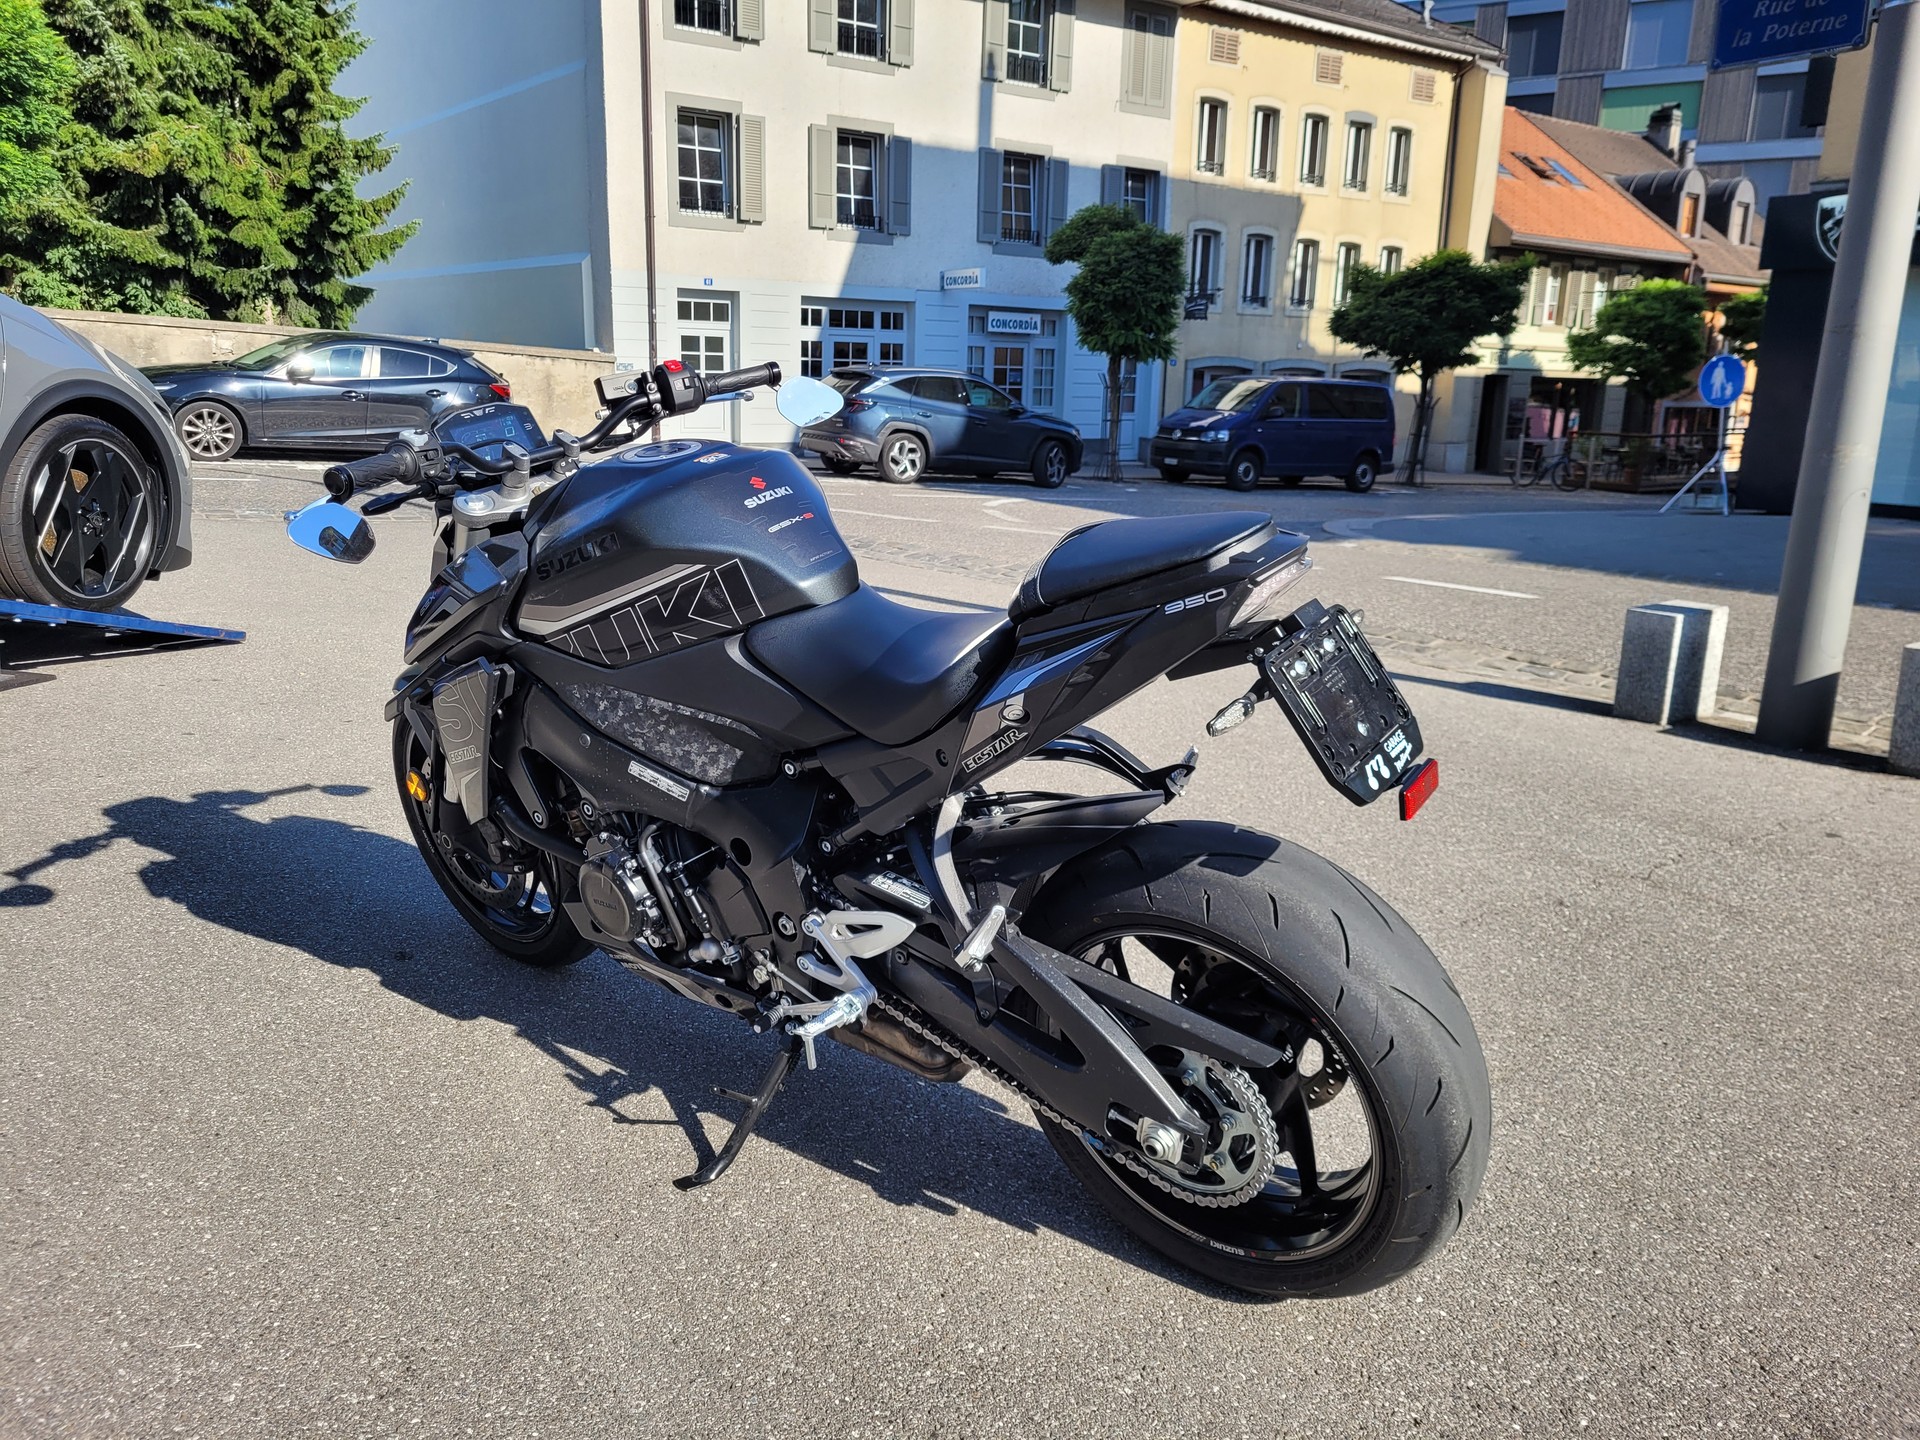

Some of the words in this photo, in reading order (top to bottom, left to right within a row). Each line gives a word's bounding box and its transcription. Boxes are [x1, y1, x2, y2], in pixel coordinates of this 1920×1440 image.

[1753, 0, 1796, 18] Rue
[1732, 28, 1752, 48] la
[1762, 14, 1848, 43] Poterne
[945, 272, 979, 287] CONCORDIA
[990, 317, 1038, 331] CONCORDIA
[743, 485, 794, 509] SUZUKI
[535, 531, 621, 582] SUZUKI
[1164, 587, 1228, 615] 950
[961, 728, 1029, 773] ECSTAR
[1383, 729, 1406, 753] GARAGE
[448, 744, 481, 765] ECSTAR
[1320, 1028, 1350, 1067] SUZUKI
[1209, 1239, 1246, 1257] SUZUKI
